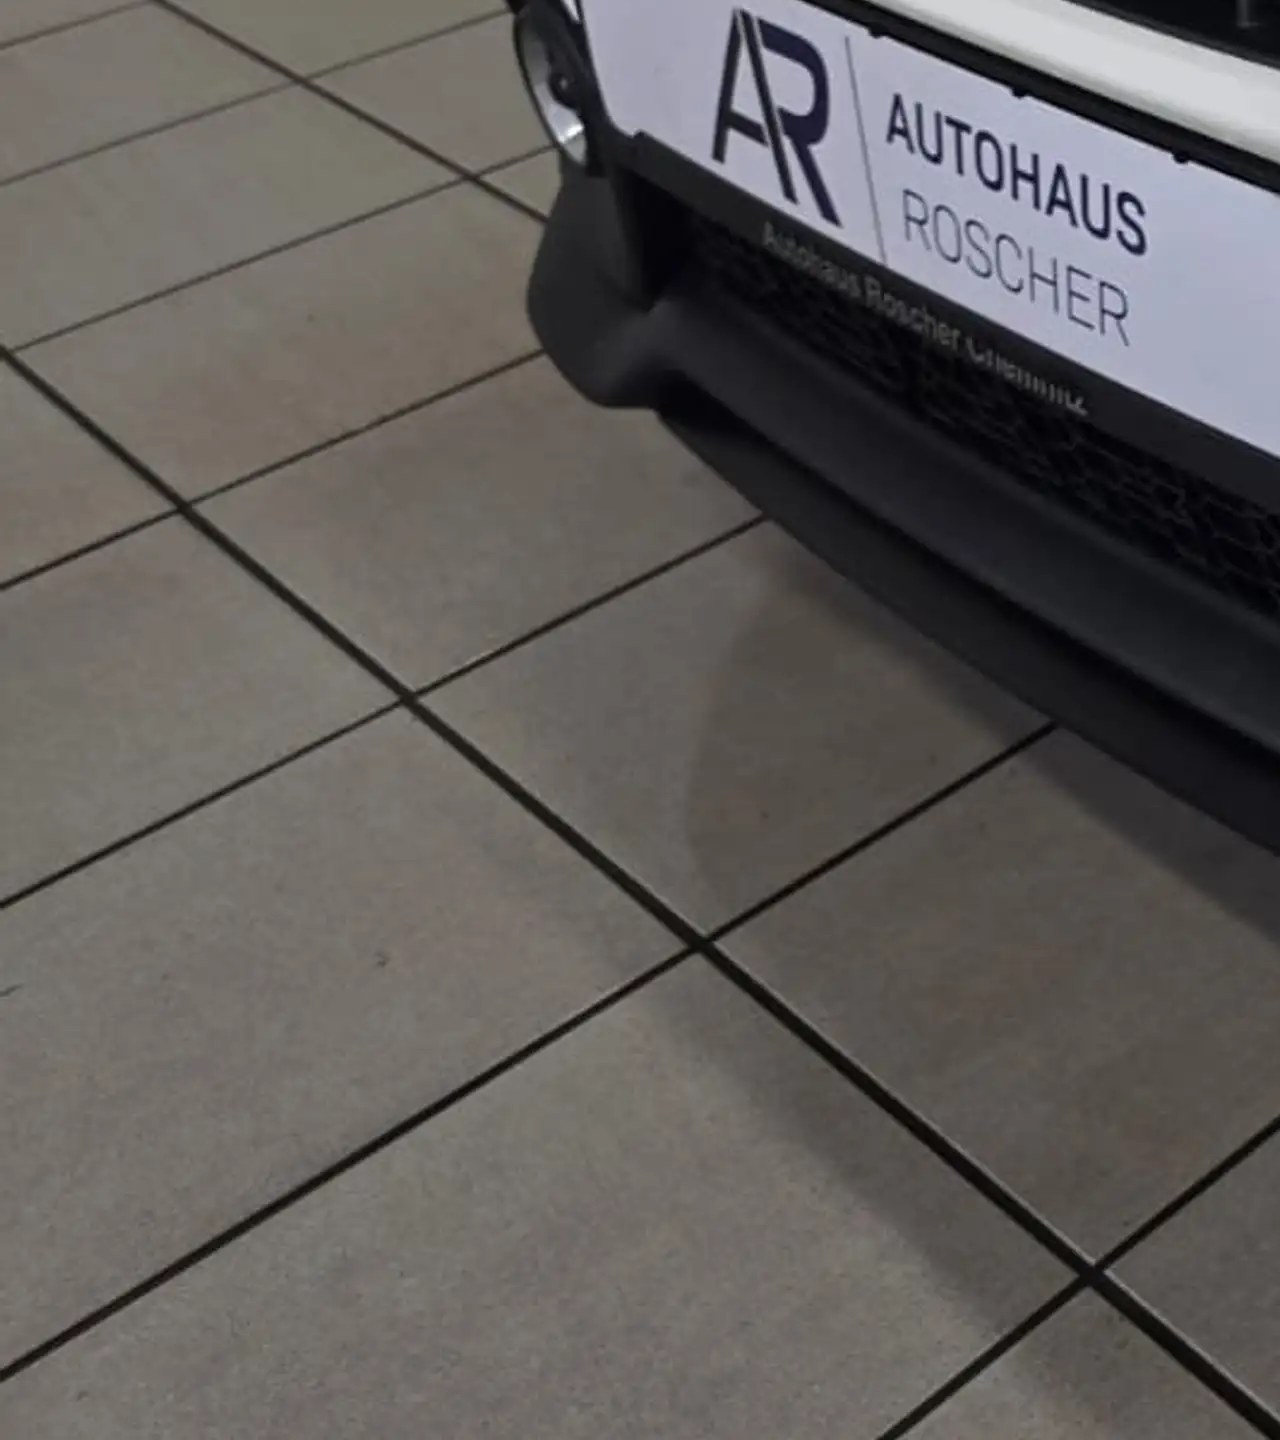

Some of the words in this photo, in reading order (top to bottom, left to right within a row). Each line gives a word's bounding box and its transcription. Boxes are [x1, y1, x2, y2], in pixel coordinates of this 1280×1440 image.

[710, 7, 844, 230] AR
[886, 92, 1148, 258] AUTOHAUS
[864, 274, 961, 351] Roscher
[902, 188, 1131, 348] ROSCHER
